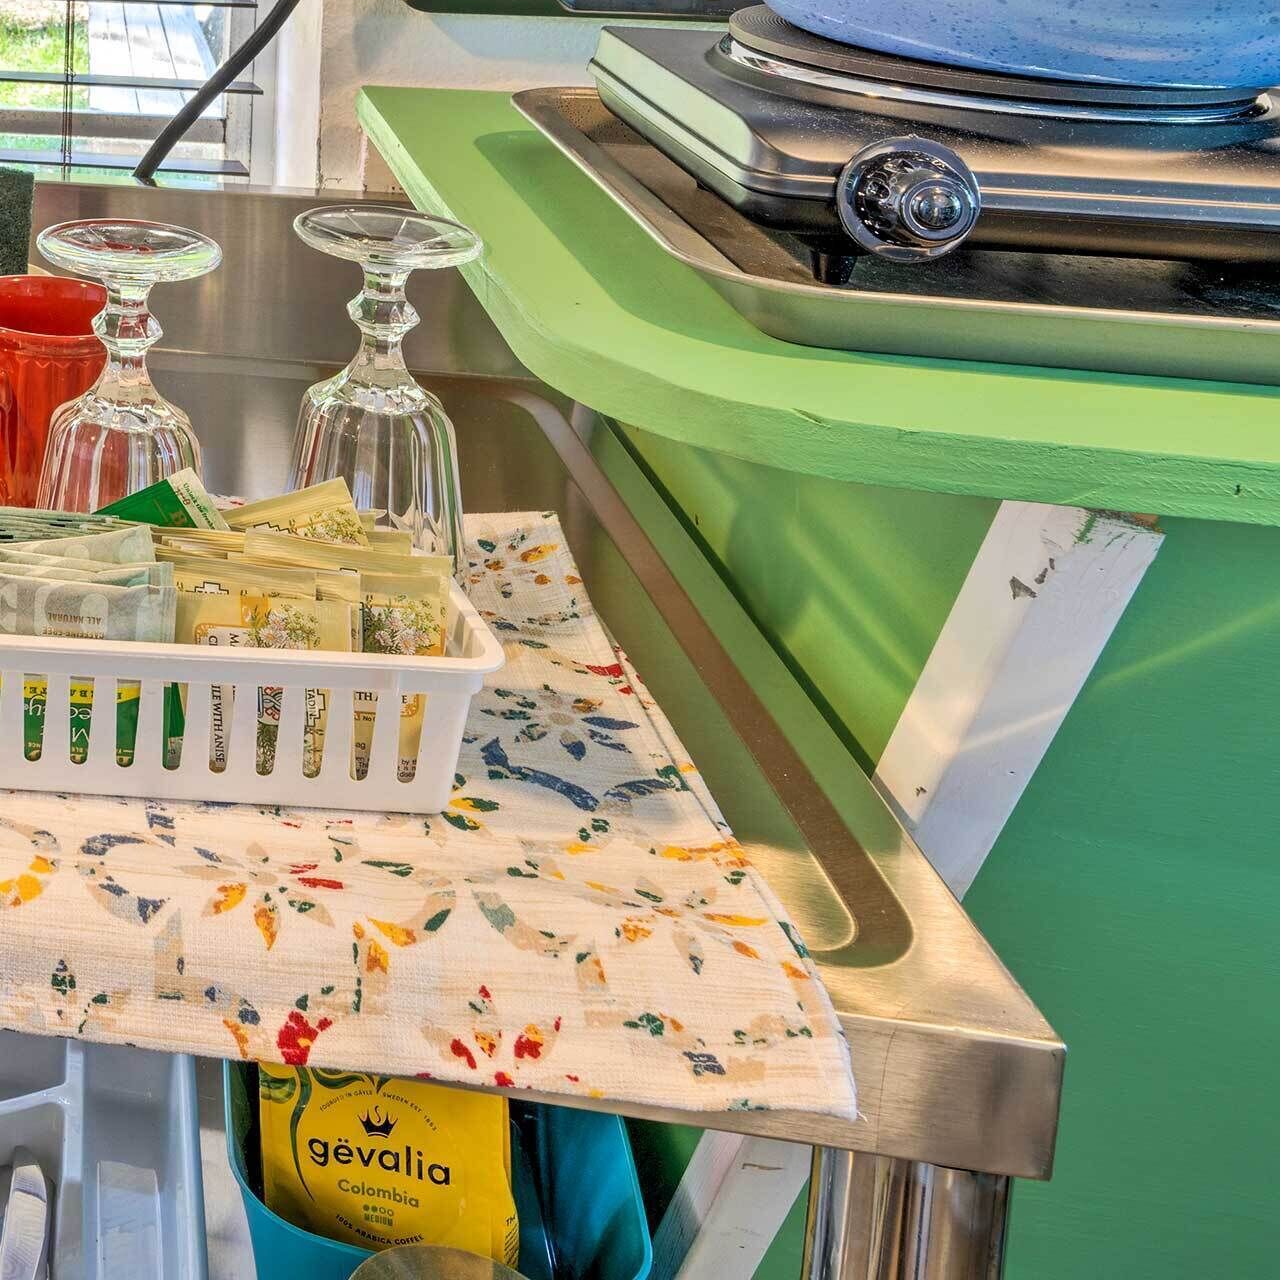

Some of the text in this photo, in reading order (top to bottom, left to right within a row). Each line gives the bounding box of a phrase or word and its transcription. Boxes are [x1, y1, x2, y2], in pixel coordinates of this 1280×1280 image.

[48, 611, 83, 624] NATURAL
[86, 616, 102, 625] ALL
[214, 703, 223, 734] WITH
[215, 734, 225, 763] ANISE
[382, 1091, 409, 1105] SWEDEN
[308, 1137, 451, 1186] gëvalia
[337, 1179, 420, 1208] Colombia
[335, 1214, 425, 1245] 100% ARABICA COFFEE
[364, 1213, 394, 1227] MEDIUM
